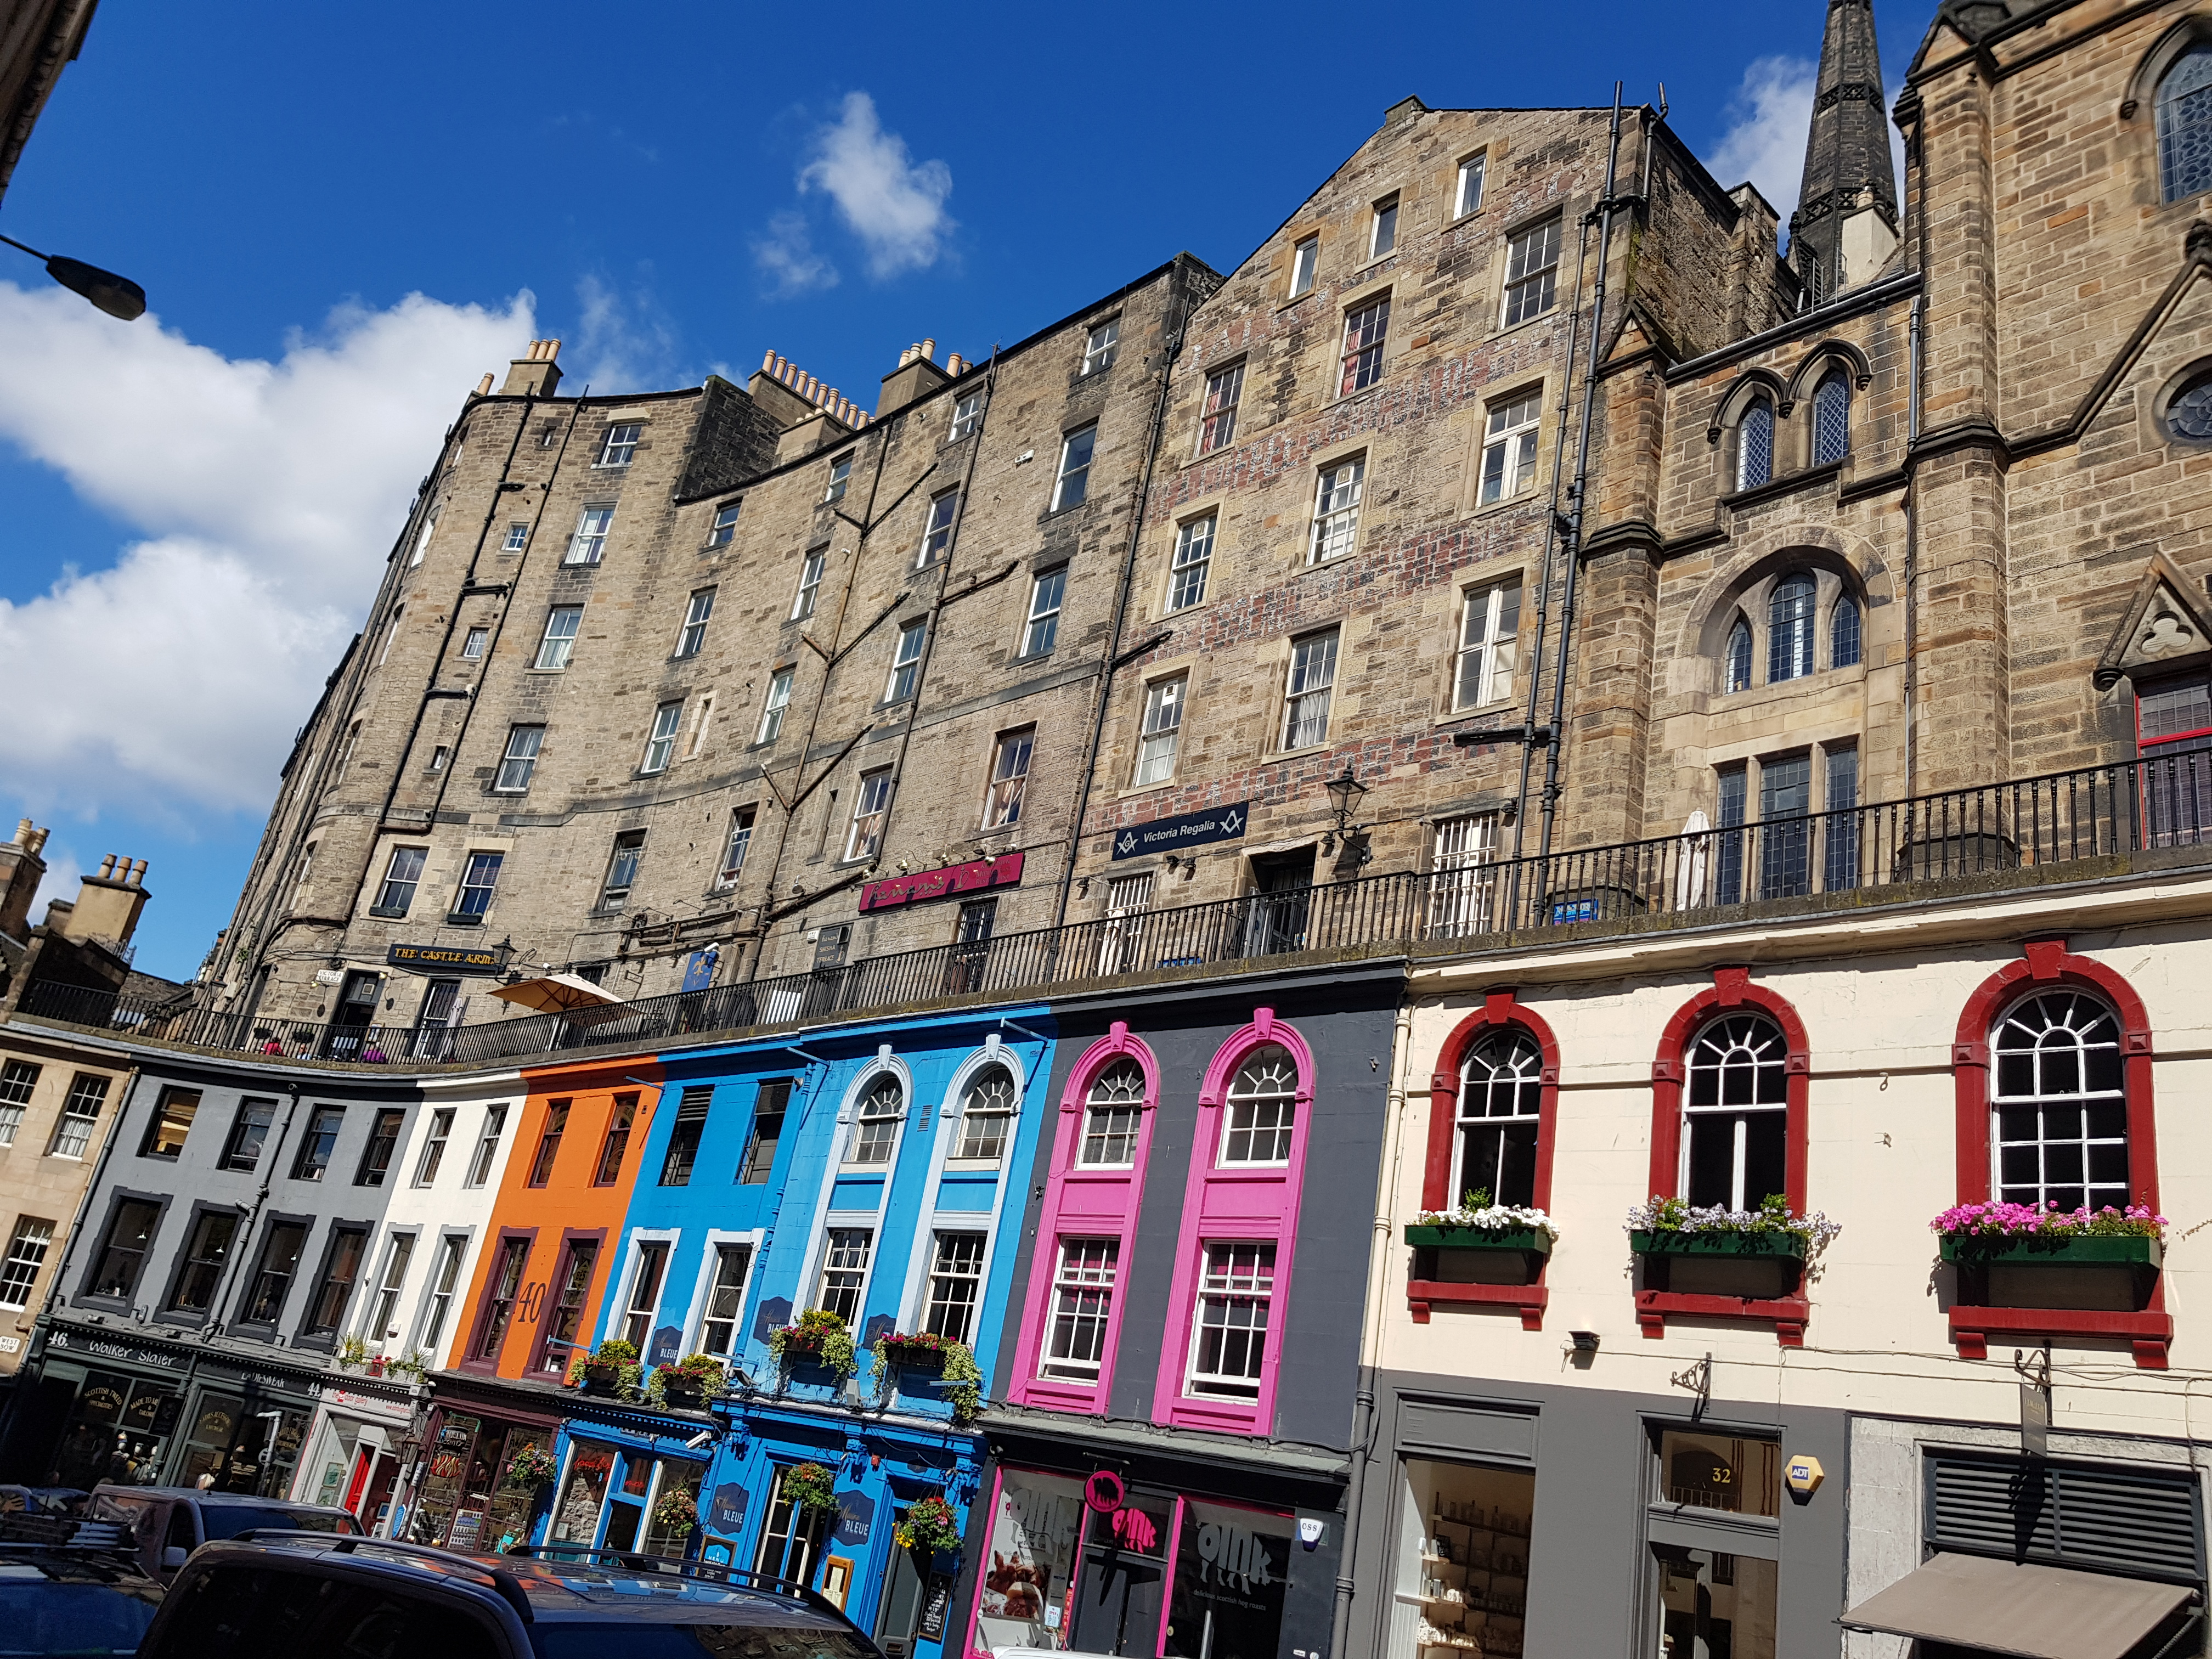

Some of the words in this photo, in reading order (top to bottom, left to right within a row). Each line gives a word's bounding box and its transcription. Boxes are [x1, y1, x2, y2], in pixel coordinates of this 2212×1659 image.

[1144, 828, 1177, 843] Victoria
[1180, 821, 1215, 837] Regalia
[395, 947, 417, 958] THE
[420, 950, 463, 961] CASTLE
[517, 1282, 546, 1323] 40
[89, 1340, 133, 1358] Walker
[659, 1347, 678, 1360] BLEUE
[1712, 1467, 1731, 1483] 32
[1792, 1468, 1809, 1478] ADT
[723, 1509, 744, 1524] BLEUE
[844, 1519, 869, 1537] BLEUE
[1197, 1523, 1272, 1587] oink
[1193, 1589, 1216, 1600] delicious
[1216, 1595, 1237, 1605] scottish
[1238, 1598, 1249, 1609] hog
[1249, 1602, 1266, 1611] roasts
